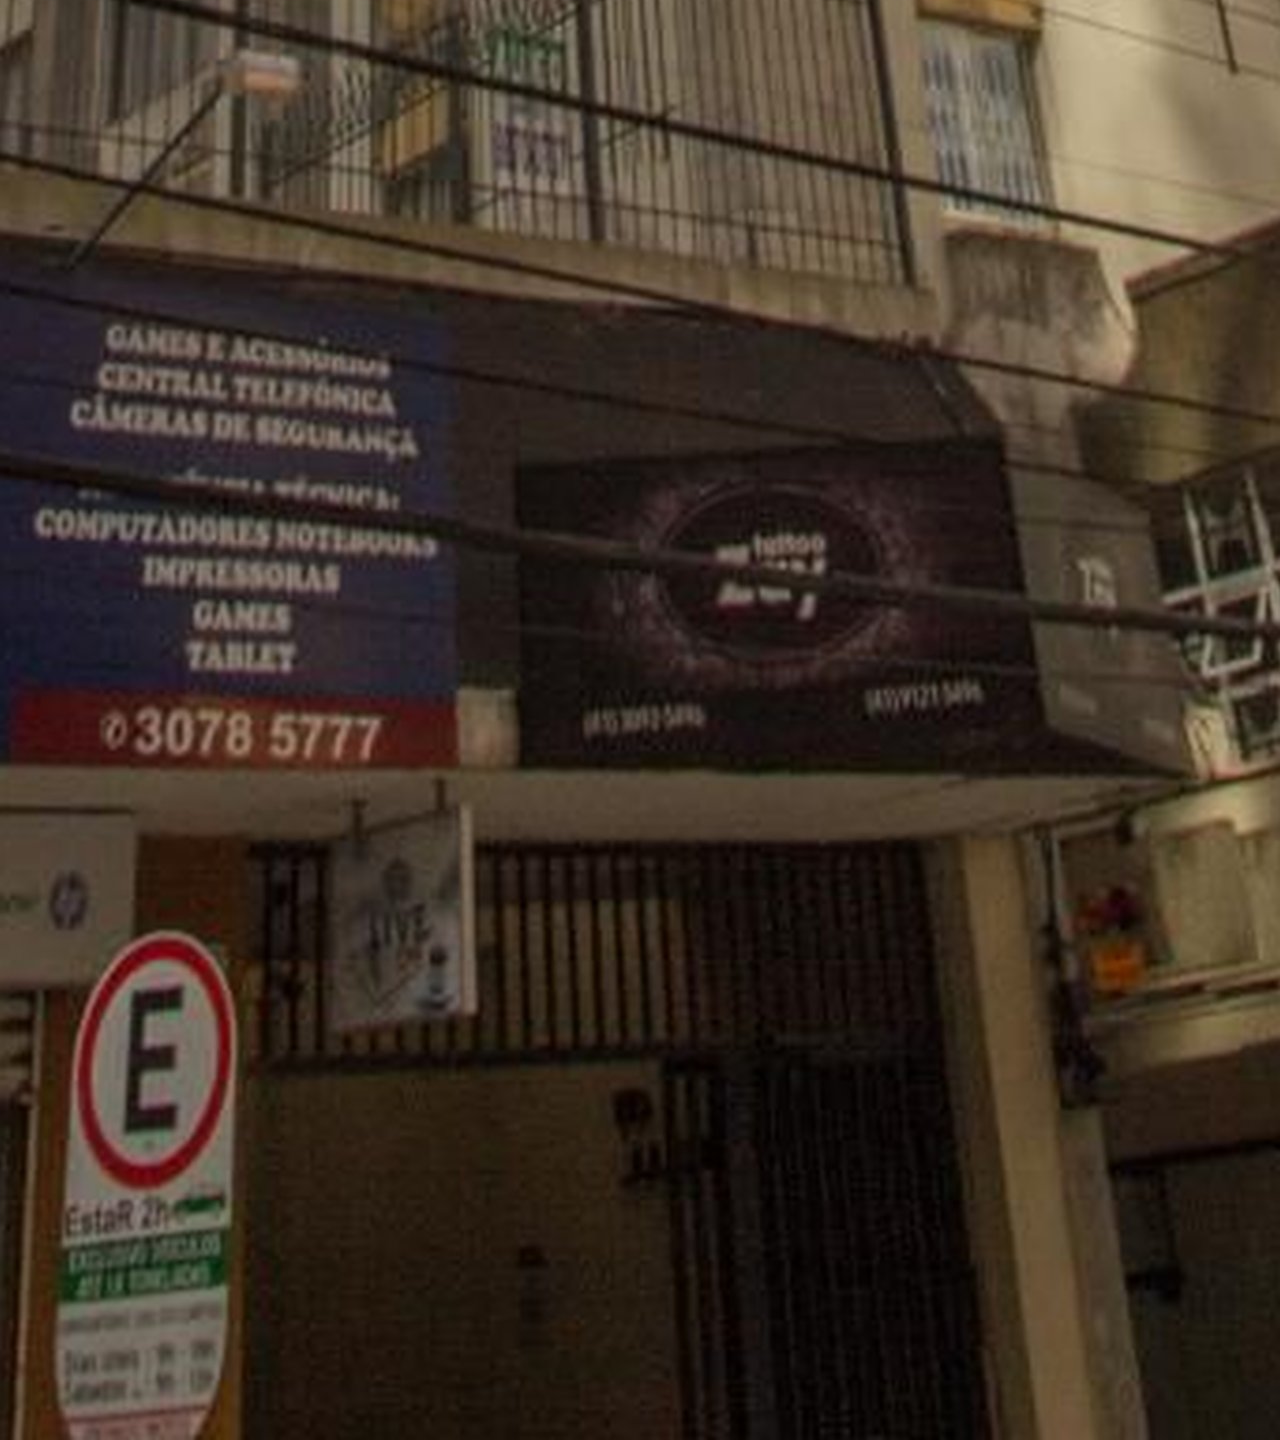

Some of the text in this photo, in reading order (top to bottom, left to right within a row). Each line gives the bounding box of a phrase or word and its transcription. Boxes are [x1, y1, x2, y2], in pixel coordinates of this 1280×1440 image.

[105, 323, 201, 362] GAMES
[205, 335, 227, 362] E
[97, 363, 228, 400] CENTRAL
[212, 412, 251, 443] DE
[34, 507, 270, 549] COMPUTADORES
[142, 553, 342, 594] IMPRESSORAS
[193, 598, 292, 634] GAMES
[185, 638, 297, 675] TABLET
[134, 706, 384, 761] 3078 5777
[124, 985, 183, 1134] E
[65, 1200, 133, 1237] EstaR
